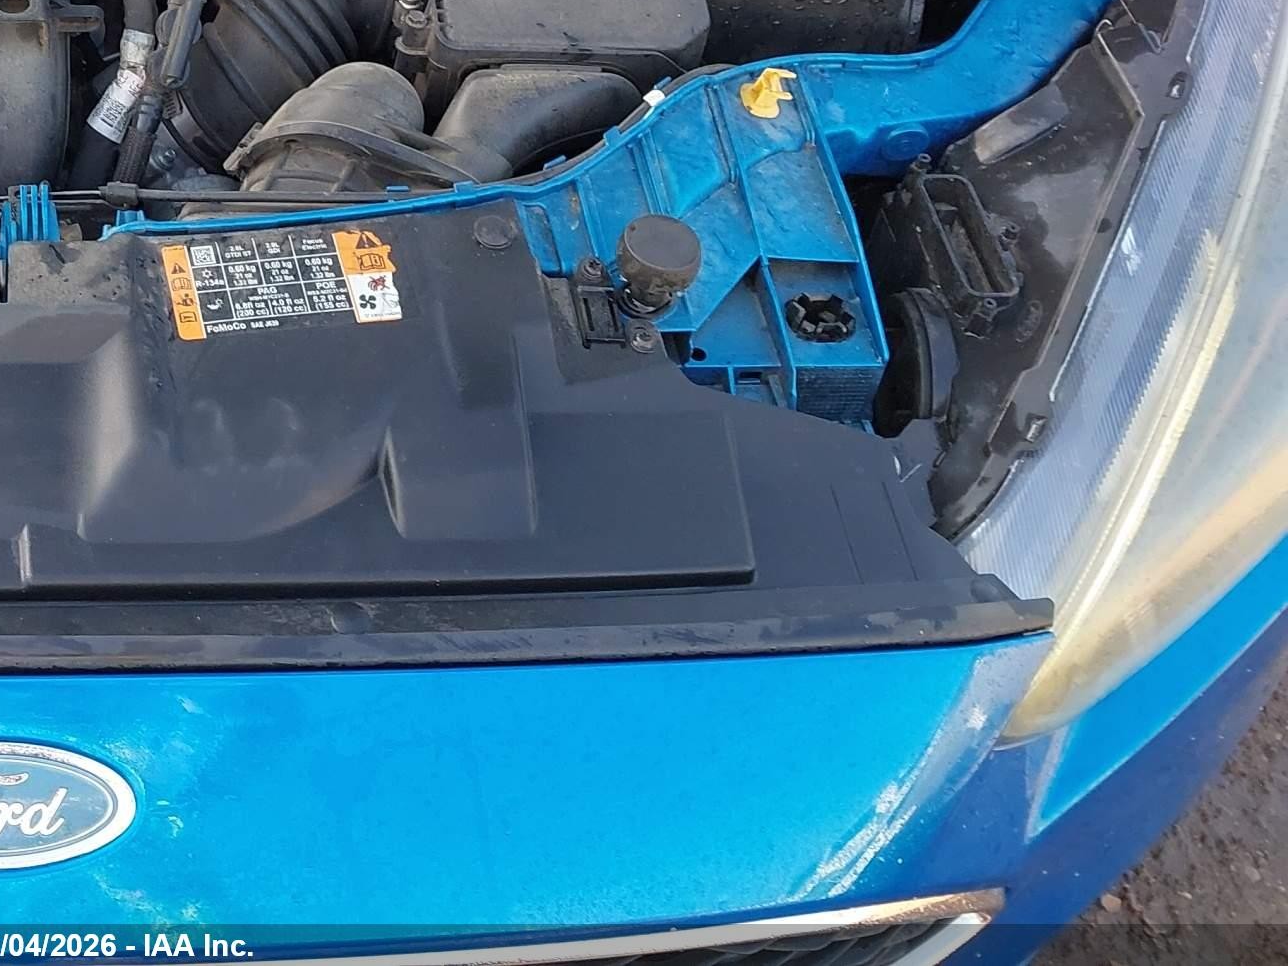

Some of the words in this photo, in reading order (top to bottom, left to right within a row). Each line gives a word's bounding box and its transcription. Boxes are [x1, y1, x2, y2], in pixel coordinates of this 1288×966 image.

[264, 261, 281, 270] 0.60
[281, 260, 293, 269] kg
[304, 257, 322, 266] 0.60
[321, 256, 334, 266] kg
[228, 264, 245, 273] 0.60
[244, 264, 257, 273] kg
[257, 286, 278, 295] PAG
[315, 281, 337, 290] POE
[274, 305, 293, 315] (120
[293, 304, 308, 313] cc)
[335, 301, 350, 309] cc)
[255, 307, 270, 317] cc)
[206, 322, 247, 333] FoMoCo
